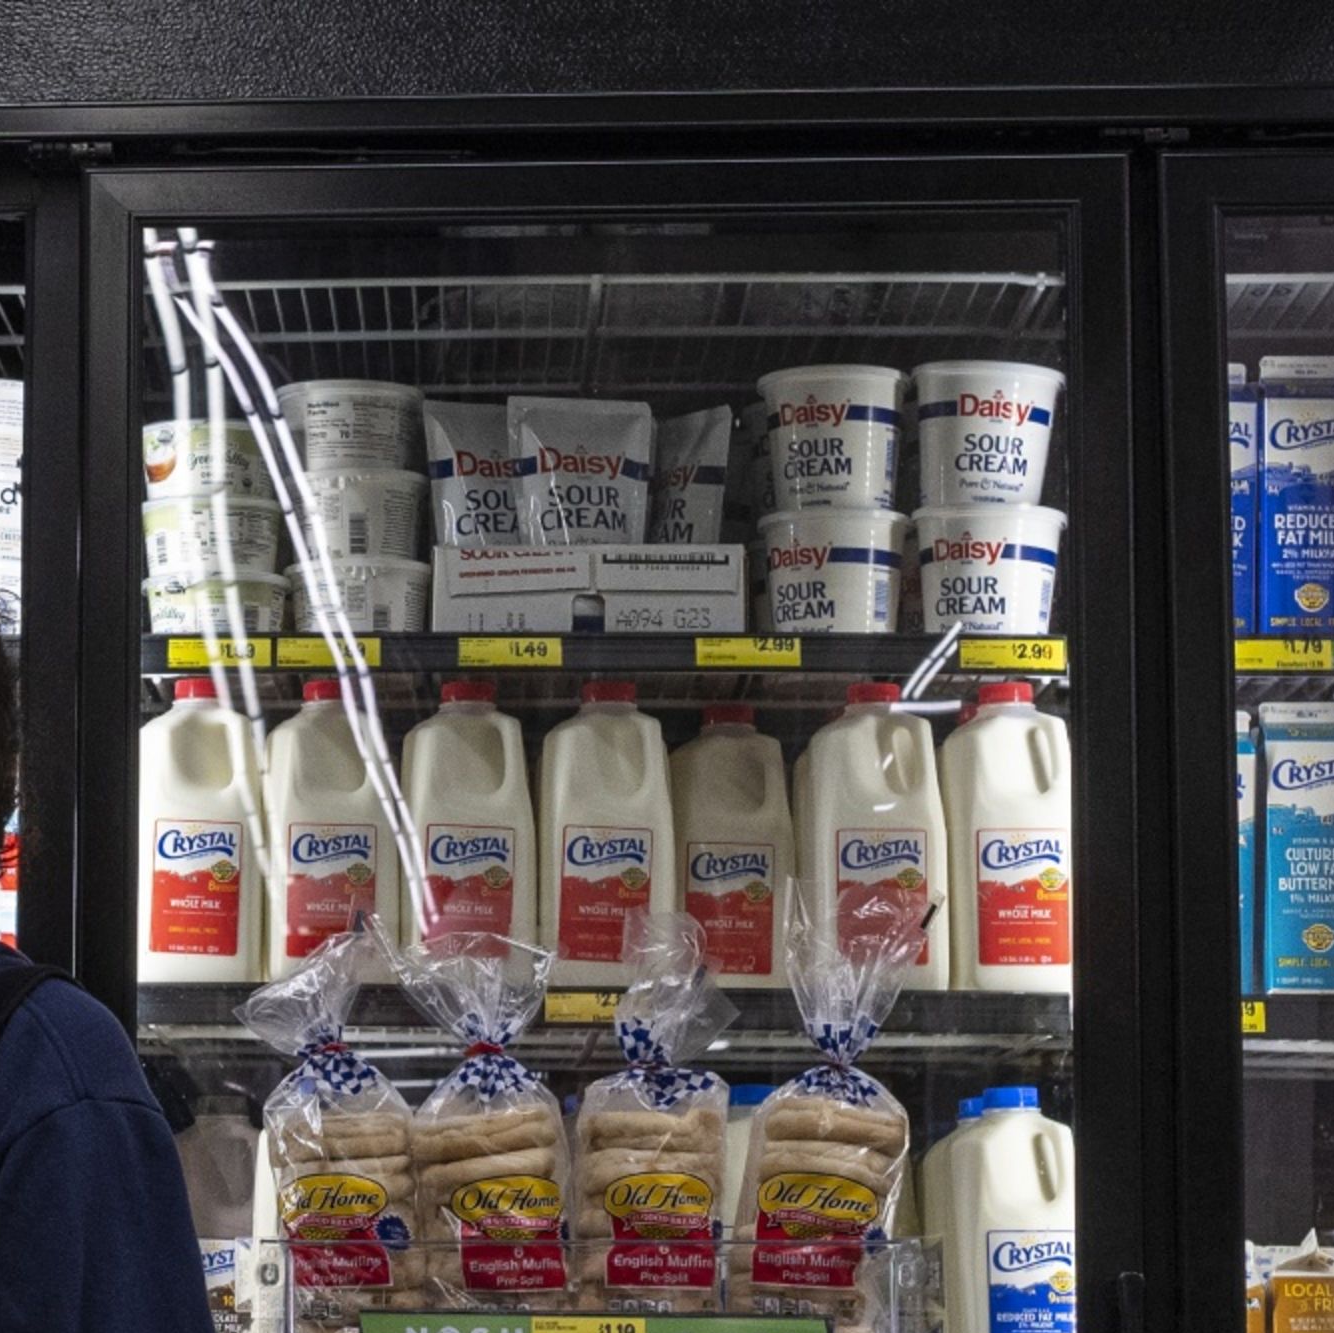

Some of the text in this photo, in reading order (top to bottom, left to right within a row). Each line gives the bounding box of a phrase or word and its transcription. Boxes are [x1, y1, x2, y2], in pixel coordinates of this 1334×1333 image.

[779, 402, 848, 427] Daisy
[959, 393, 1031, 426] Daisy
[788, 438, 843, 457] SOUR
[964, 434, 1024, 455] SOUR
[539, 448, 621, 479] Daisy
[784, 457, 852, 479] CREAM
[955, 453, 1027, 476] CREAM
[549, 485, 619, 507] SOUR
[541, 513, 626, 532] CREAM
[1277, 531, 1304, 546] FAT
[771, 545, 829, 570] Daisy
[934, 539, 1003, 565] Daisy
[777, 581, 826, 602] SOUR
[940, 577, 998, 596] SOUR
[776, 600, 835, 624] CREAM
[936, 597, 1005, 616] CREAM
[673, 608, 711, 629] G23
[431, 835, 510, 864] CRYSTAL
[841, 840, 922, 869] CRYSTAL
[981, 840, 1063, 869] CRYSTAL
[691, 851, 770, 881] CRYSTAL
[1290, 862, 1319, 875] LOW
[998, 909, 1029, 919] WHOLE
[319, 1187, 379, 1210] Home
[459, 1187, 499, 1209] Old
[610, 1186, 707, 1208] Old Home
[764, 1181, 872, 1214] Old Home
[470, 1260, 520, 1272] English
[614, 1255, 663, 1268] English
[758, 1252, 810, 1265] English
[496, 1275, 544, 1286] Pre-Split
[640, 1271, 689, 1284] Pre-Split
[782, 1270, 830, 1282] Pre-Split
[1284, 1283, 1333, 1297] LOCAL
